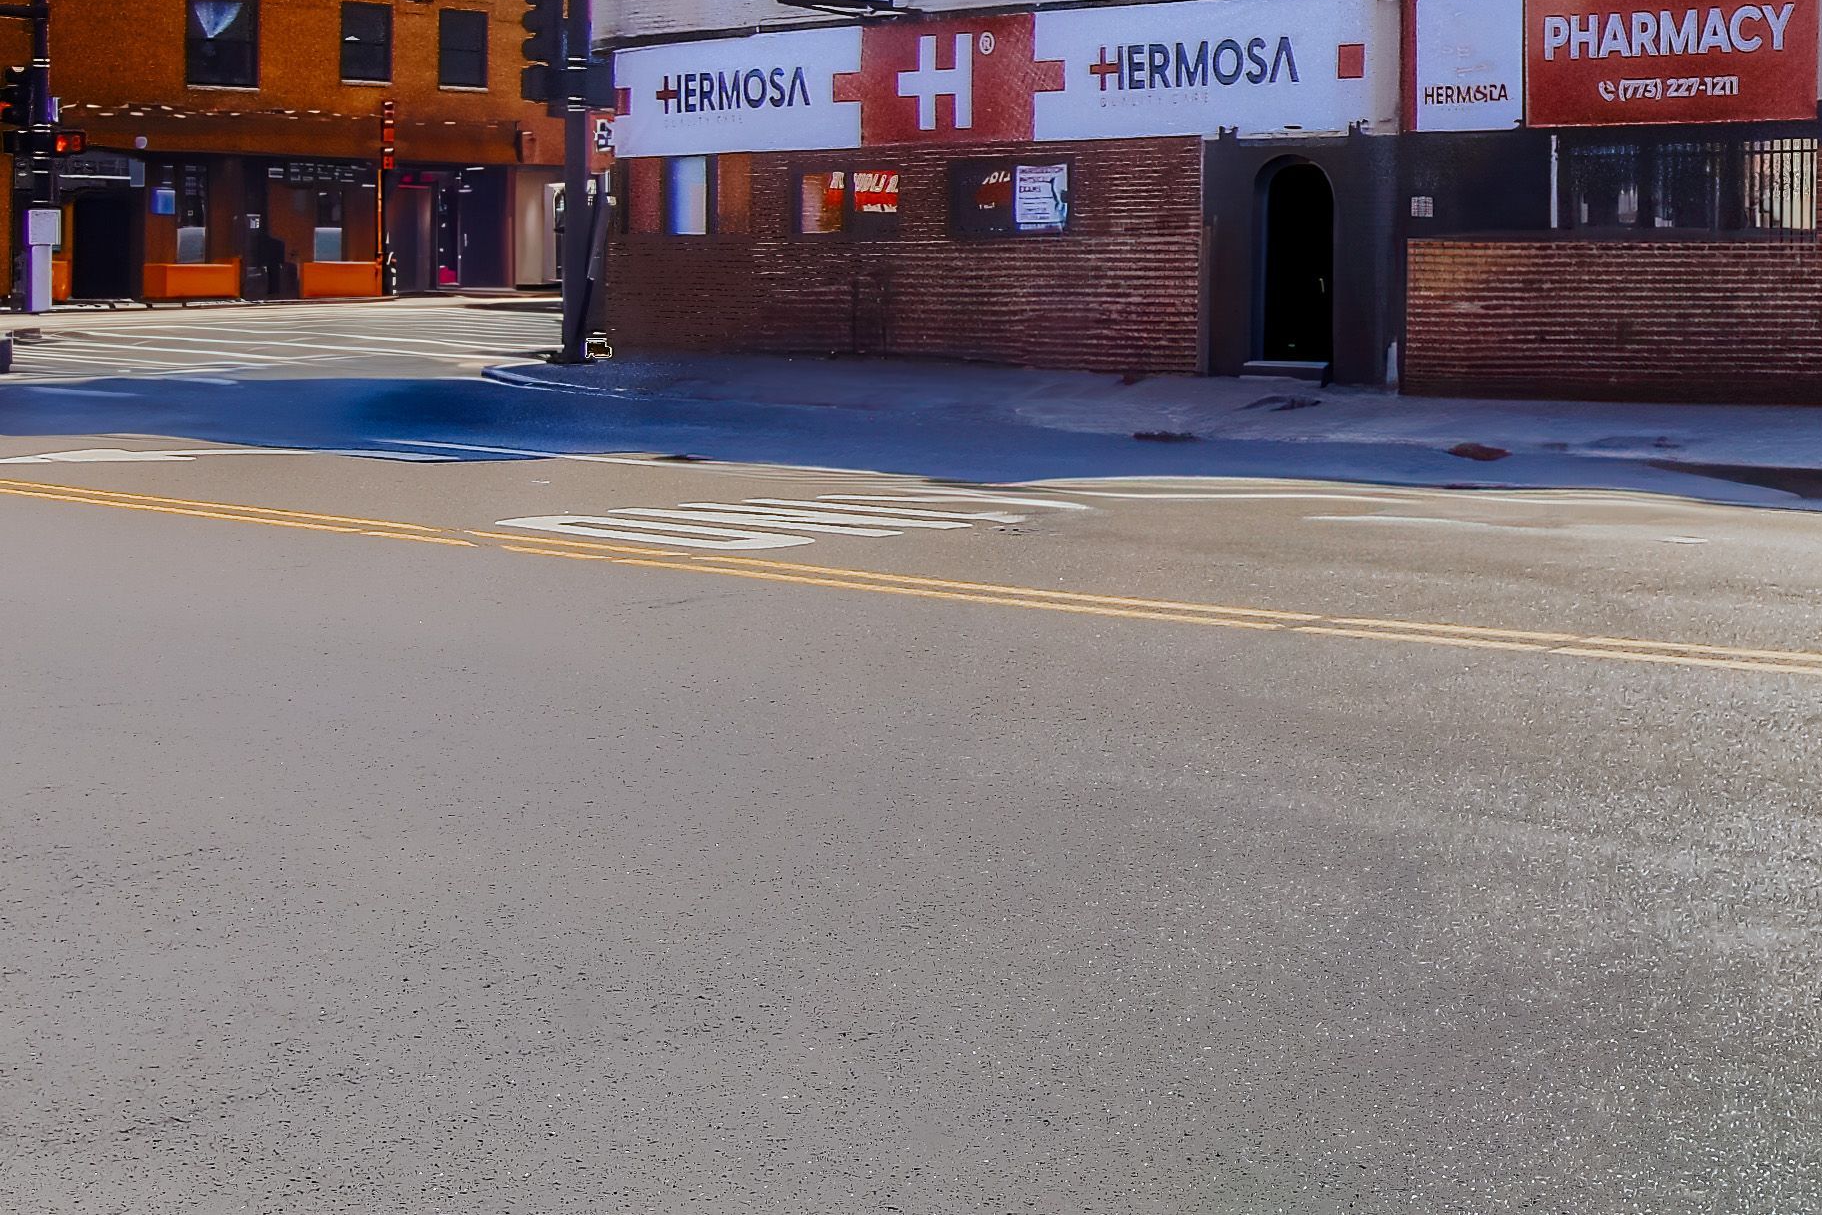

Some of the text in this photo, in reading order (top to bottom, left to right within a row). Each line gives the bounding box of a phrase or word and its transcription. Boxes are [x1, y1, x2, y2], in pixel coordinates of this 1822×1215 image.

[1543, 3, 1795, 61] PHARMACY
[656, 66, 811, 115] HERMOSA
[1089, 36, 1300, 92] HERMOSA
